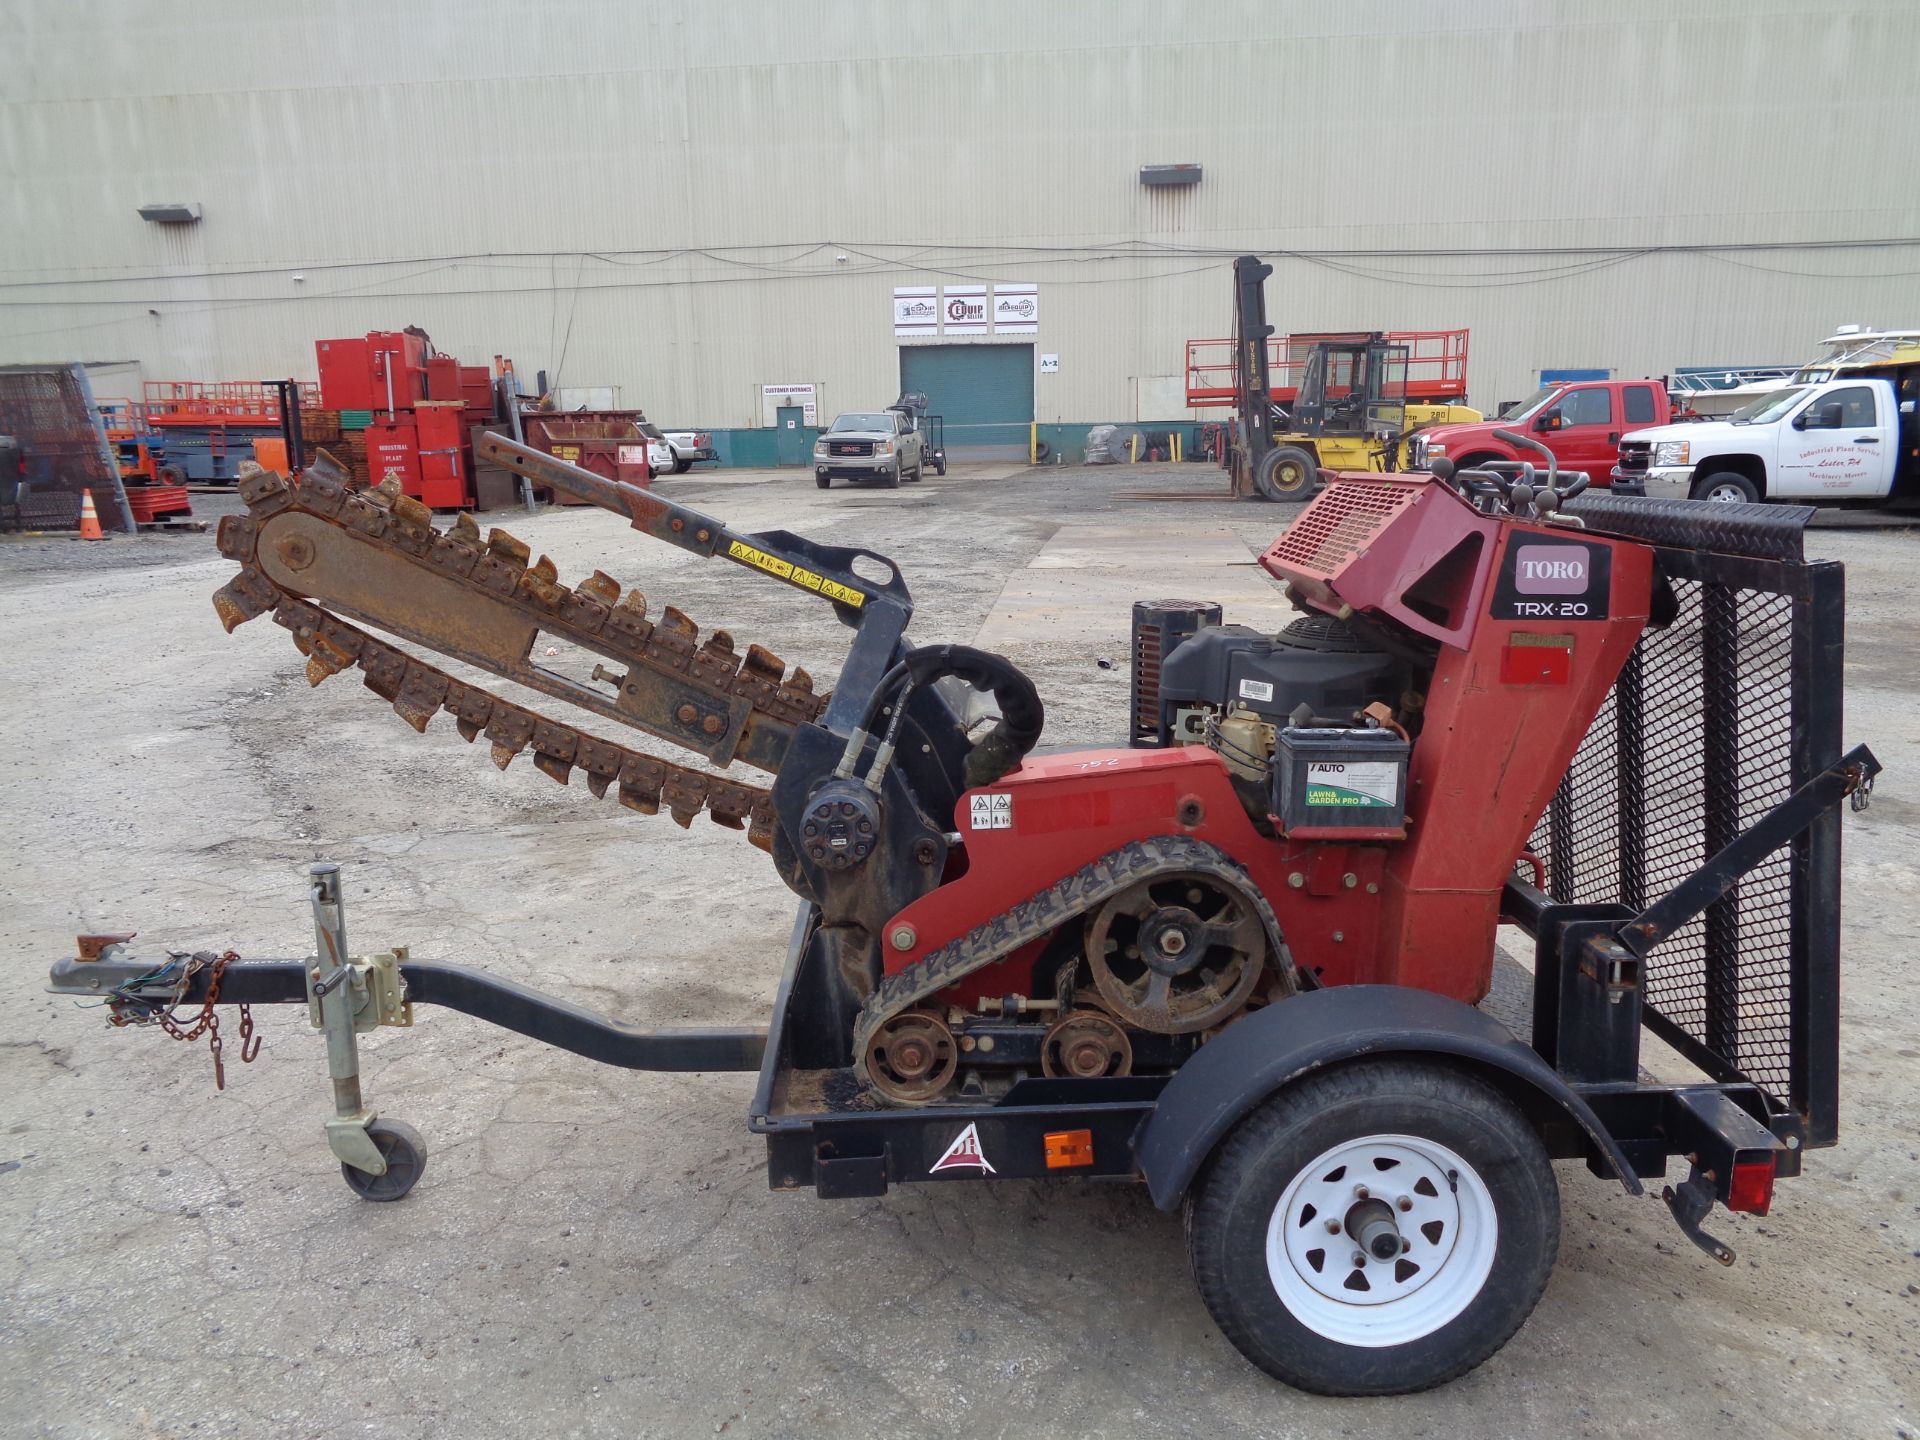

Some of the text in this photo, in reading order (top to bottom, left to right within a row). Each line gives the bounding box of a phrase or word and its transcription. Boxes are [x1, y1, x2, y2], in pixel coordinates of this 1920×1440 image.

[955, 305, 983, 314] EQUIP
[1799, 445, 1880, 459] Industrial Plant Service
[1808, 471, 1867, 480] Machinery Movers
[1522, 561, 1583, 579] TORO
[1318, 763, 1345, 773] AUTO
[1342, 797, 1359, 805] PRO
